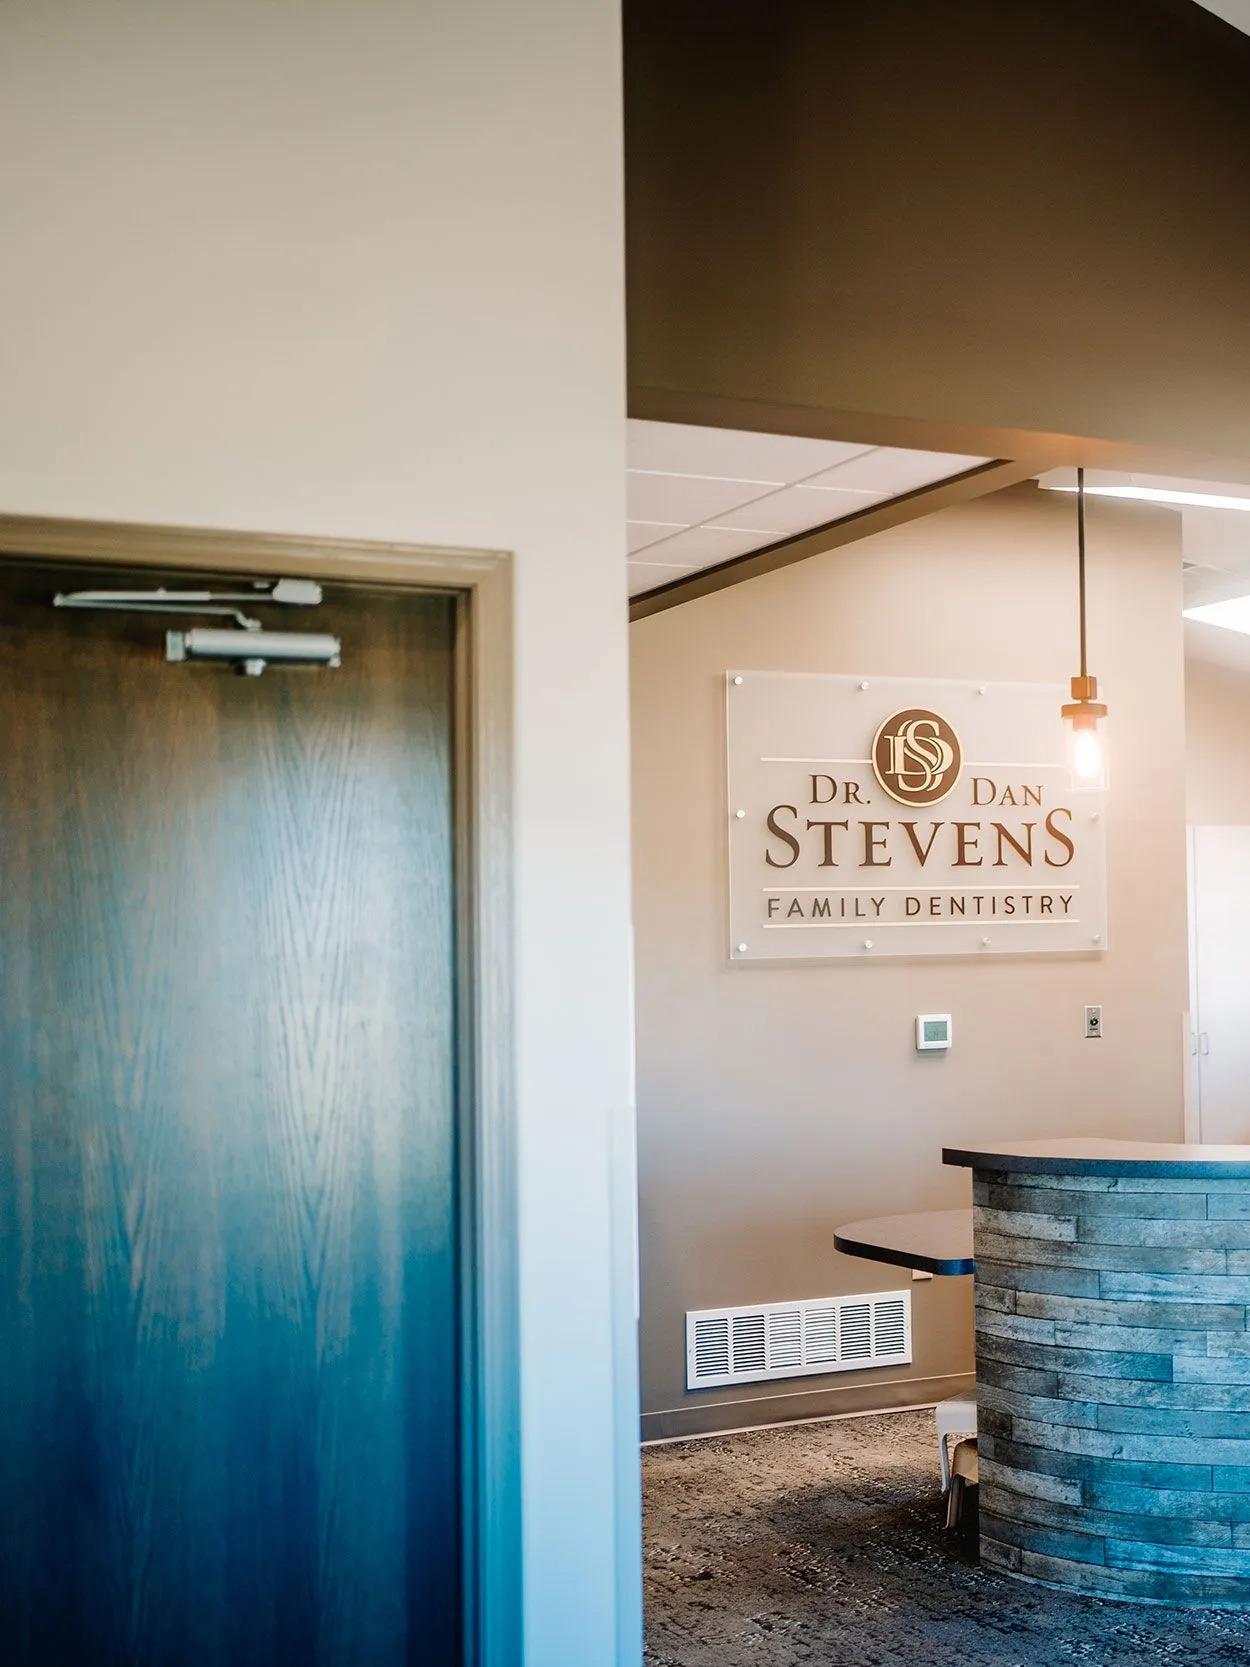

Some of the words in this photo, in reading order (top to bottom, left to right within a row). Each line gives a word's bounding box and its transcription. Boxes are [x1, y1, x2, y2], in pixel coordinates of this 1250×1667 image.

[809, 774, 872, 805] DR.
[971, 777, 1044, 807] DAN
[765, 804, 1075, 869] STEVENS
[767, 897, 886, 918] FAMILY
[905, 895, 1074, 917] DENTISTRY
